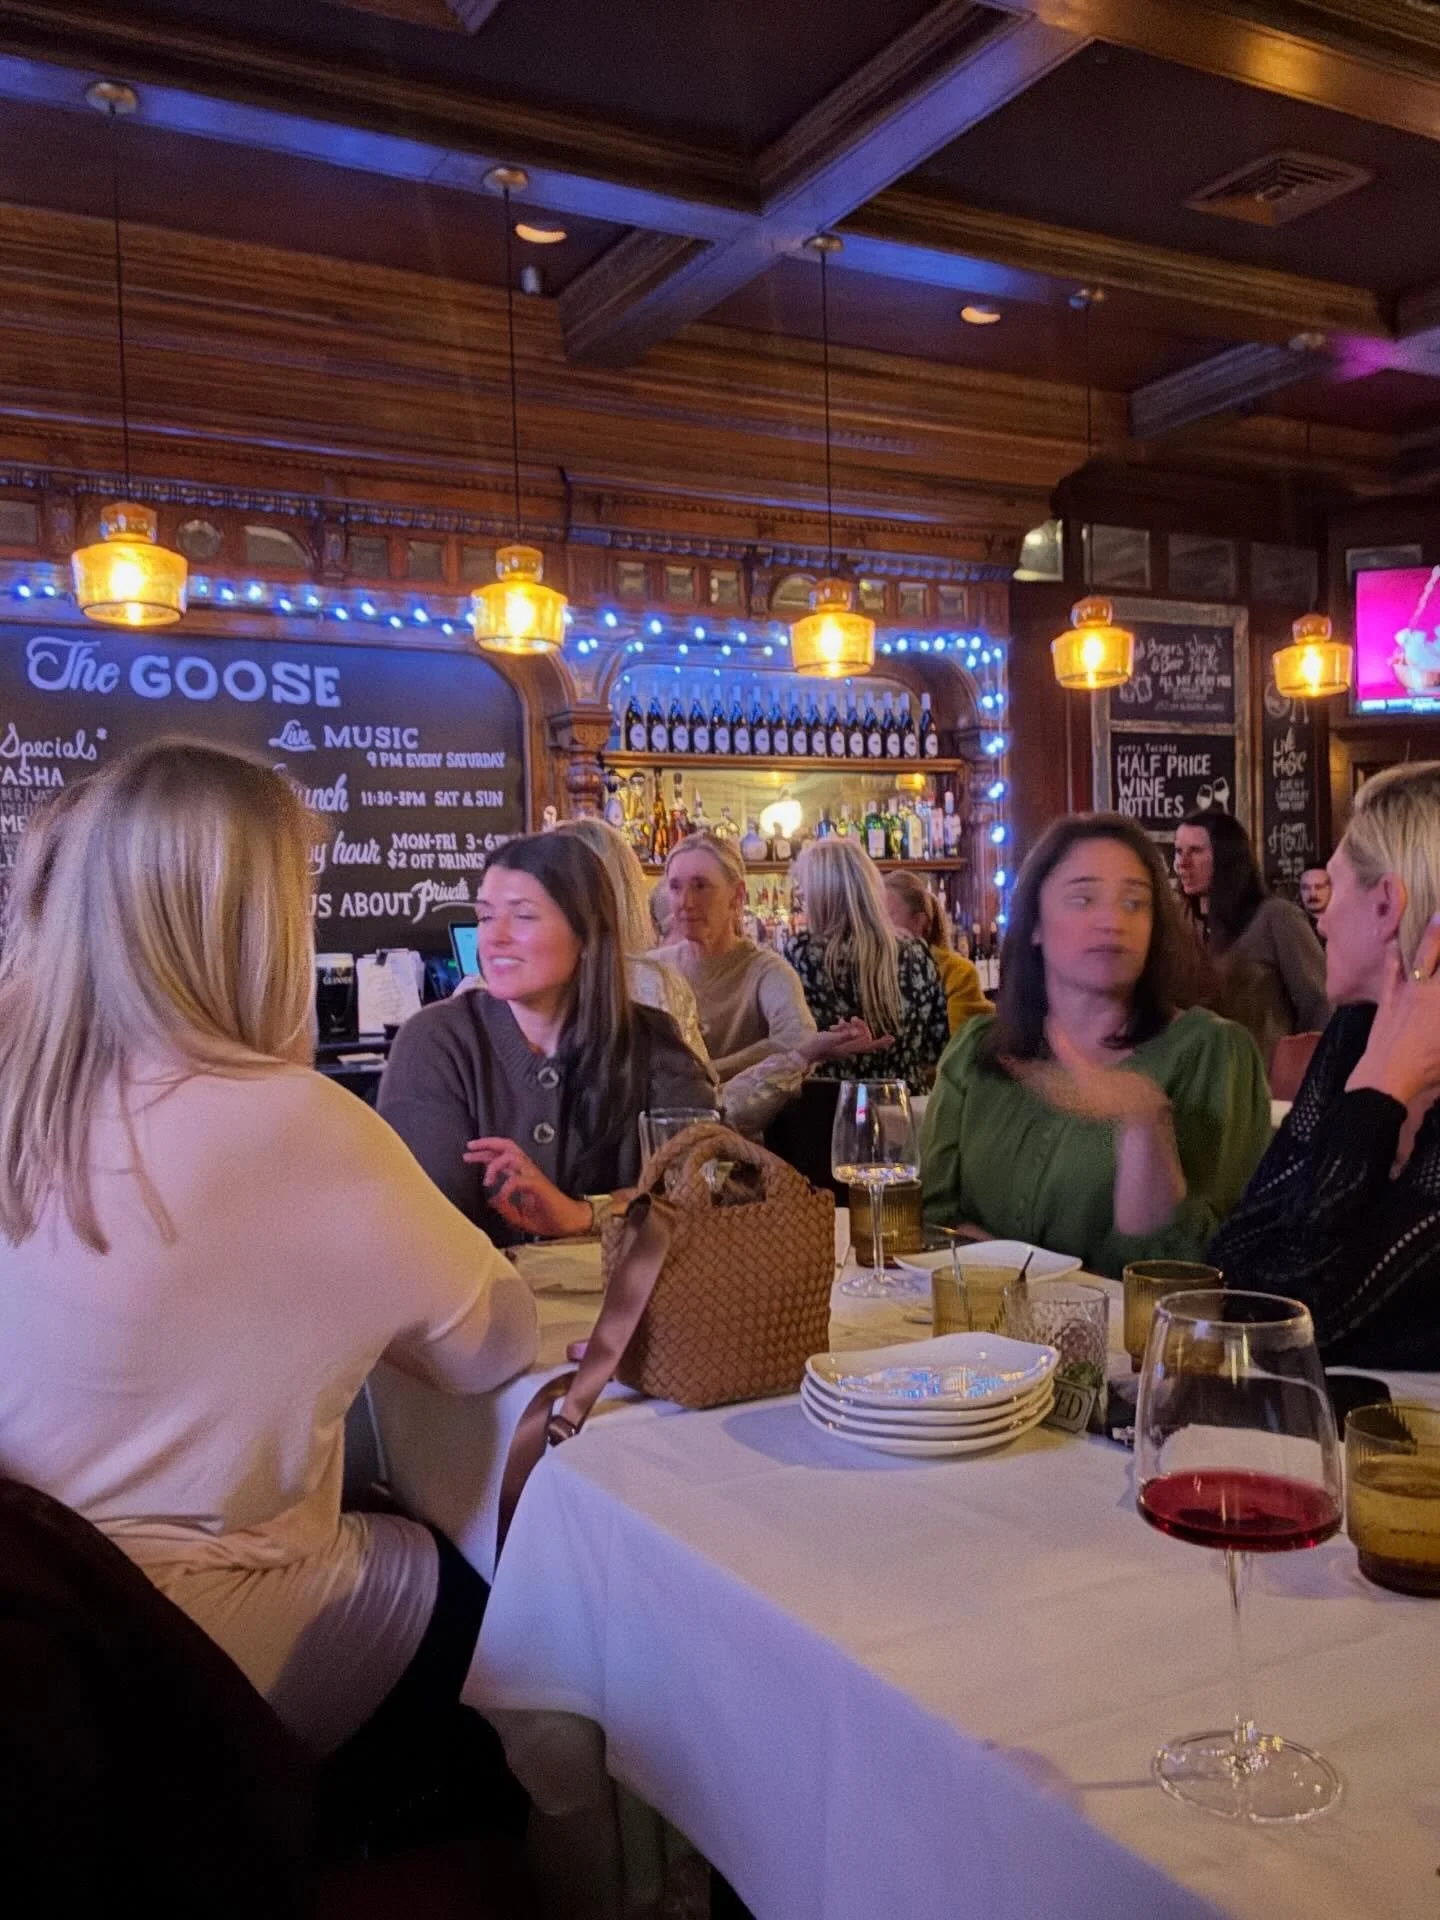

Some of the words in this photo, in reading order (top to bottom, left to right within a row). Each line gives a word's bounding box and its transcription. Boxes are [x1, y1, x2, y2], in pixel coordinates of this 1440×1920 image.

[26, 636, 121, 694] The
[129, 654, 341, 707] GOOSE
[323, 725, 419, 749] MUSIC
[366, 751, 377, 768] 9
[380, 752, 403, 767] PM
[406, 752, 443, 768] EVERY
[446, 751, 506, 769] SATURDAY
[1117, 753, 1161, 778] HALF
[1167, 753, 1212, 778] PRICE
[0, 765, 64, 787] ASHA
[1117, 776, 1167, 799] WINE
[434, 790, 460, 807] SAT
[462, 791, 474, 807] &
[475, 790, 504, 807] SUN
[1118, 794, 1185, 818] BOTTLES
[332, 829, 382, 865] hour
[392, 832, 457, 851] MON-FRI
[387, 849, 408, 869] $2
[411, 853, 435, 868] OFF
[438, 852, 486, 869] DRINKS
[339, 891, 415, 918] ABOUT
